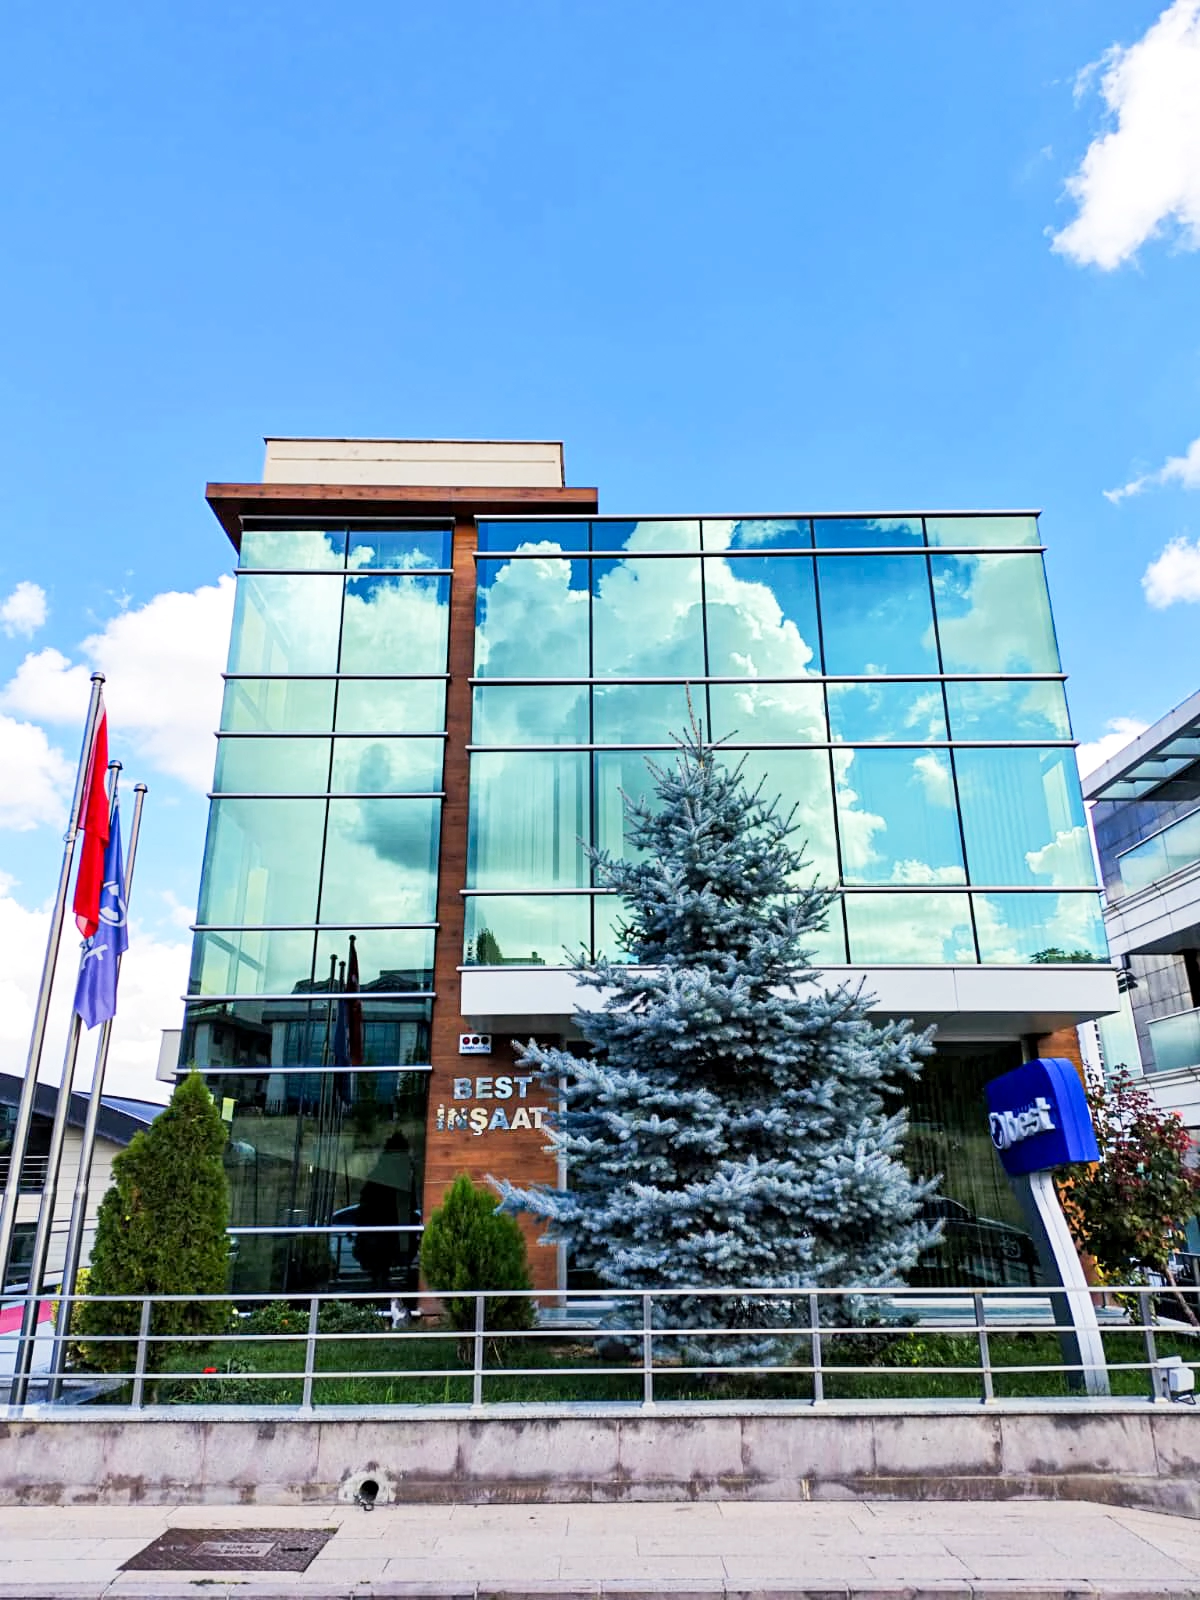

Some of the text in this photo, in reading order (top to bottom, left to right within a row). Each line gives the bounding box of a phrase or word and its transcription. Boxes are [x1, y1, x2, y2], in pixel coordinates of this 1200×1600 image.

[453, 1076, 533, 1100] BEST
[436, 1103, 548, 1136] İNŞAAT
[1003, 1097, 1056, 1142] best
